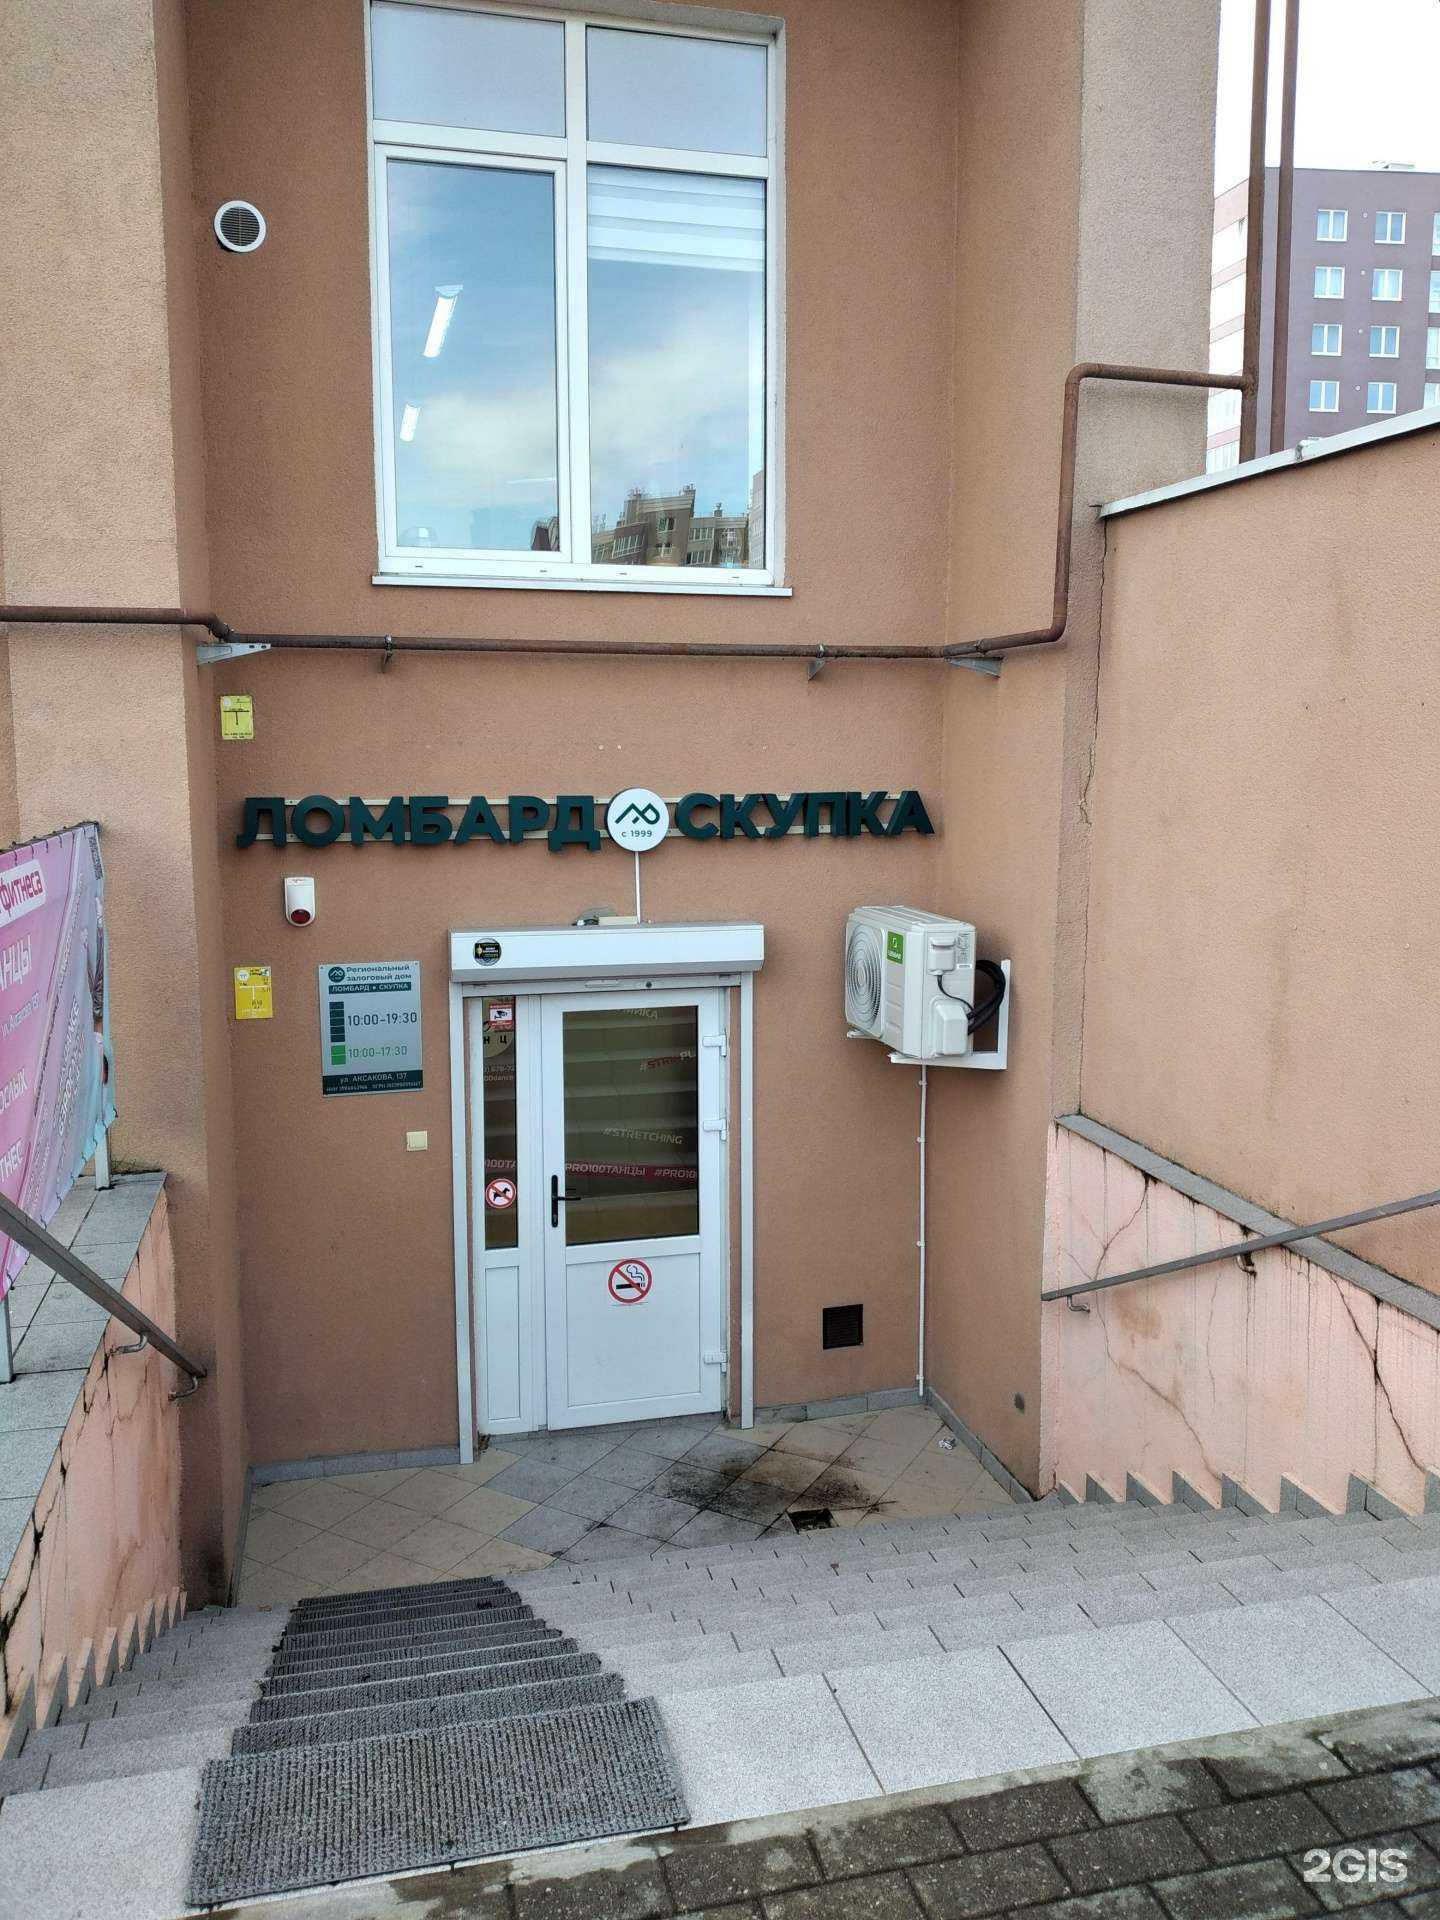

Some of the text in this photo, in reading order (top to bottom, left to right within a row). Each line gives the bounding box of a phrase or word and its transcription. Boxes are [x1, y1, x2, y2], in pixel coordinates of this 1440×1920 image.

[675, 790, 935, 839] СКУПКА
[237, 795, 601, 851] ЛОМБАРД
[630, 830, 653, 838] 1999
[346, 964, 410, 973] Региональный
[346, 973, 393, 981] залоговый
[602, 1127, 684, 1145] #STRETCHING
